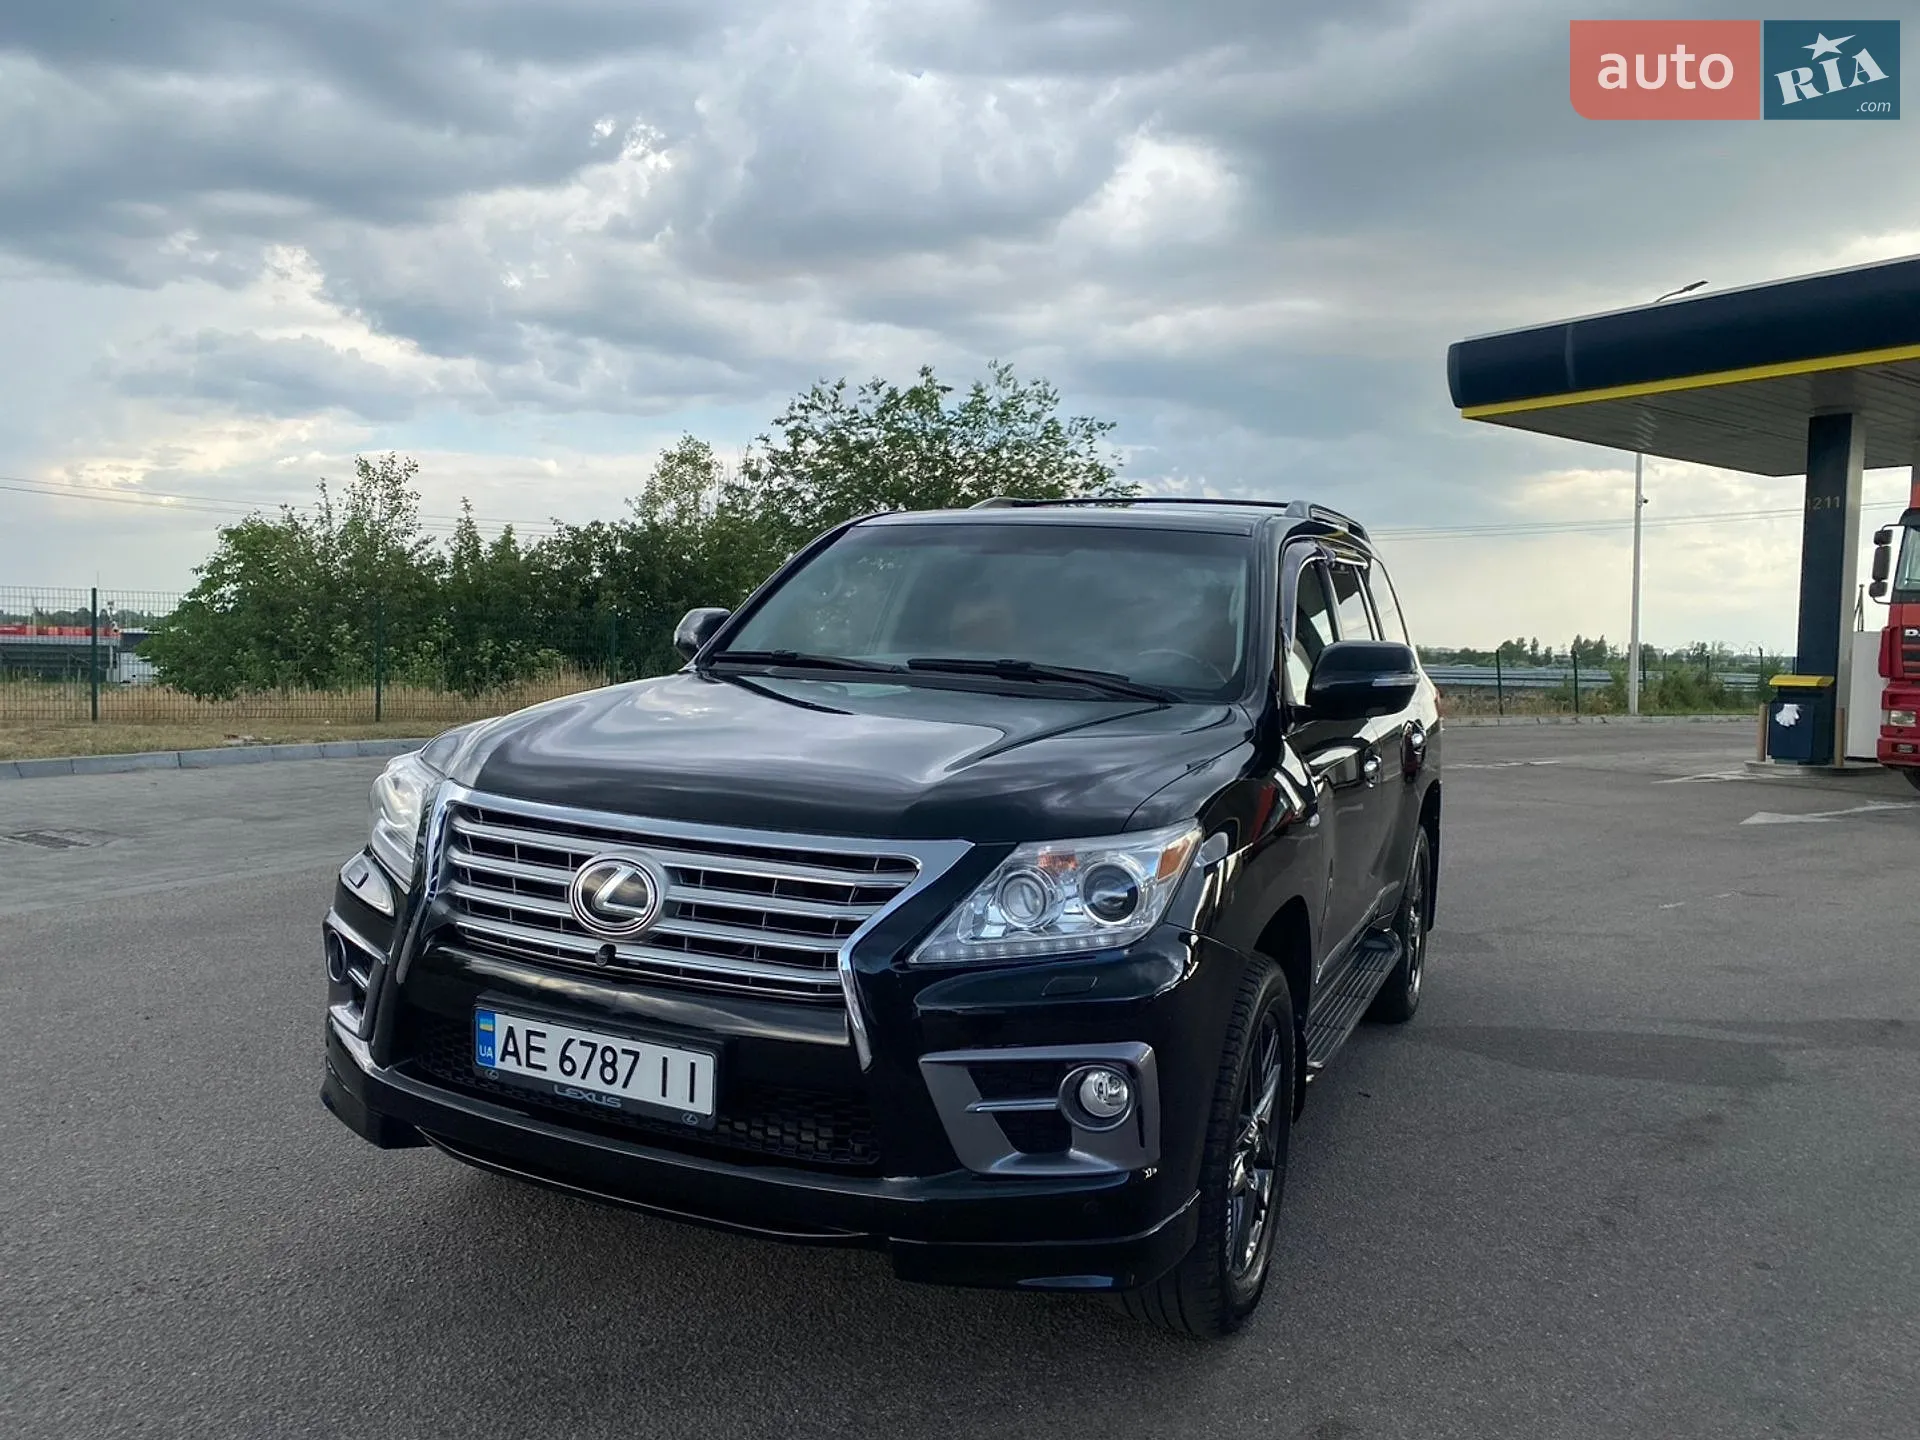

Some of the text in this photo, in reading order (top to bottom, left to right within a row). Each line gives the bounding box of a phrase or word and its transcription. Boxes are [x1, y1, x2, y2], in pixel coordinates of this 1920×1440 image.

[479, 1045, 494, 1059] UA
[500, 1025, 547, 1072] AE
[558, 1038, 640, 1089] 6787
[553, 1084, 622, 1108] LEXUS
